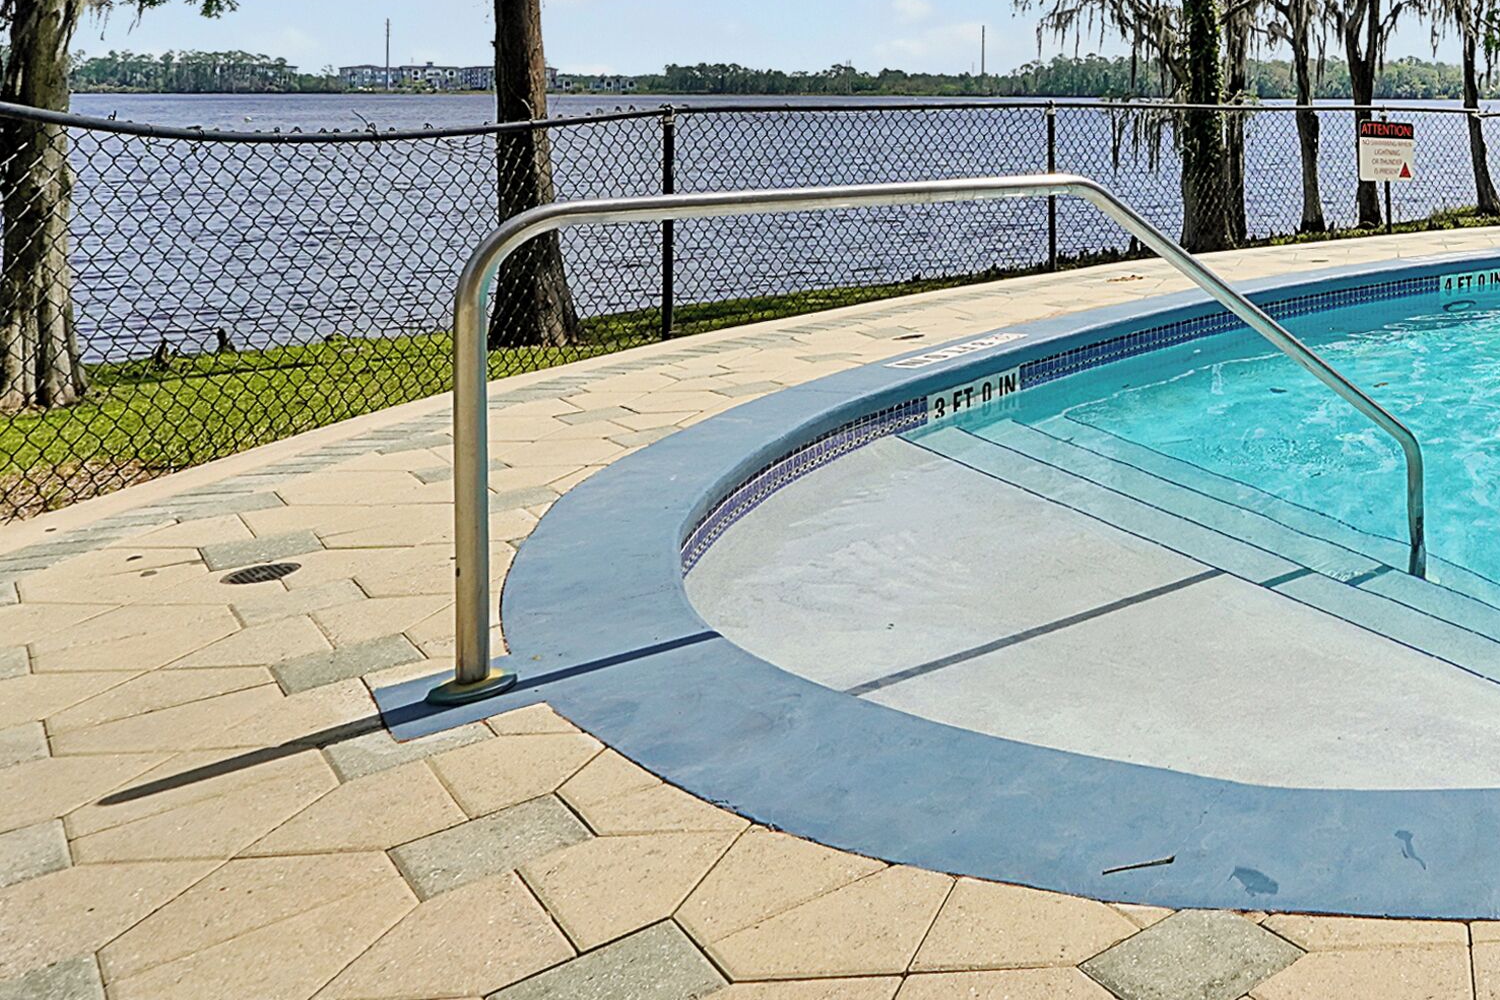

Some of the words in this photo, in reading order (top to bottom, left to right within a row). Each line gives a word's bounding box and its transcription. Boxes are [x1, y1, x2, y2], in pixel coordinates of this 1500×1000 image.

[1444, 277, 1453, 290] 4
[1457, 275, 1473, 289] FT
[934, 396, 946, 419] 3
[953, 386, 975, 413] FT
[999, 372, 1017, 397] IN
